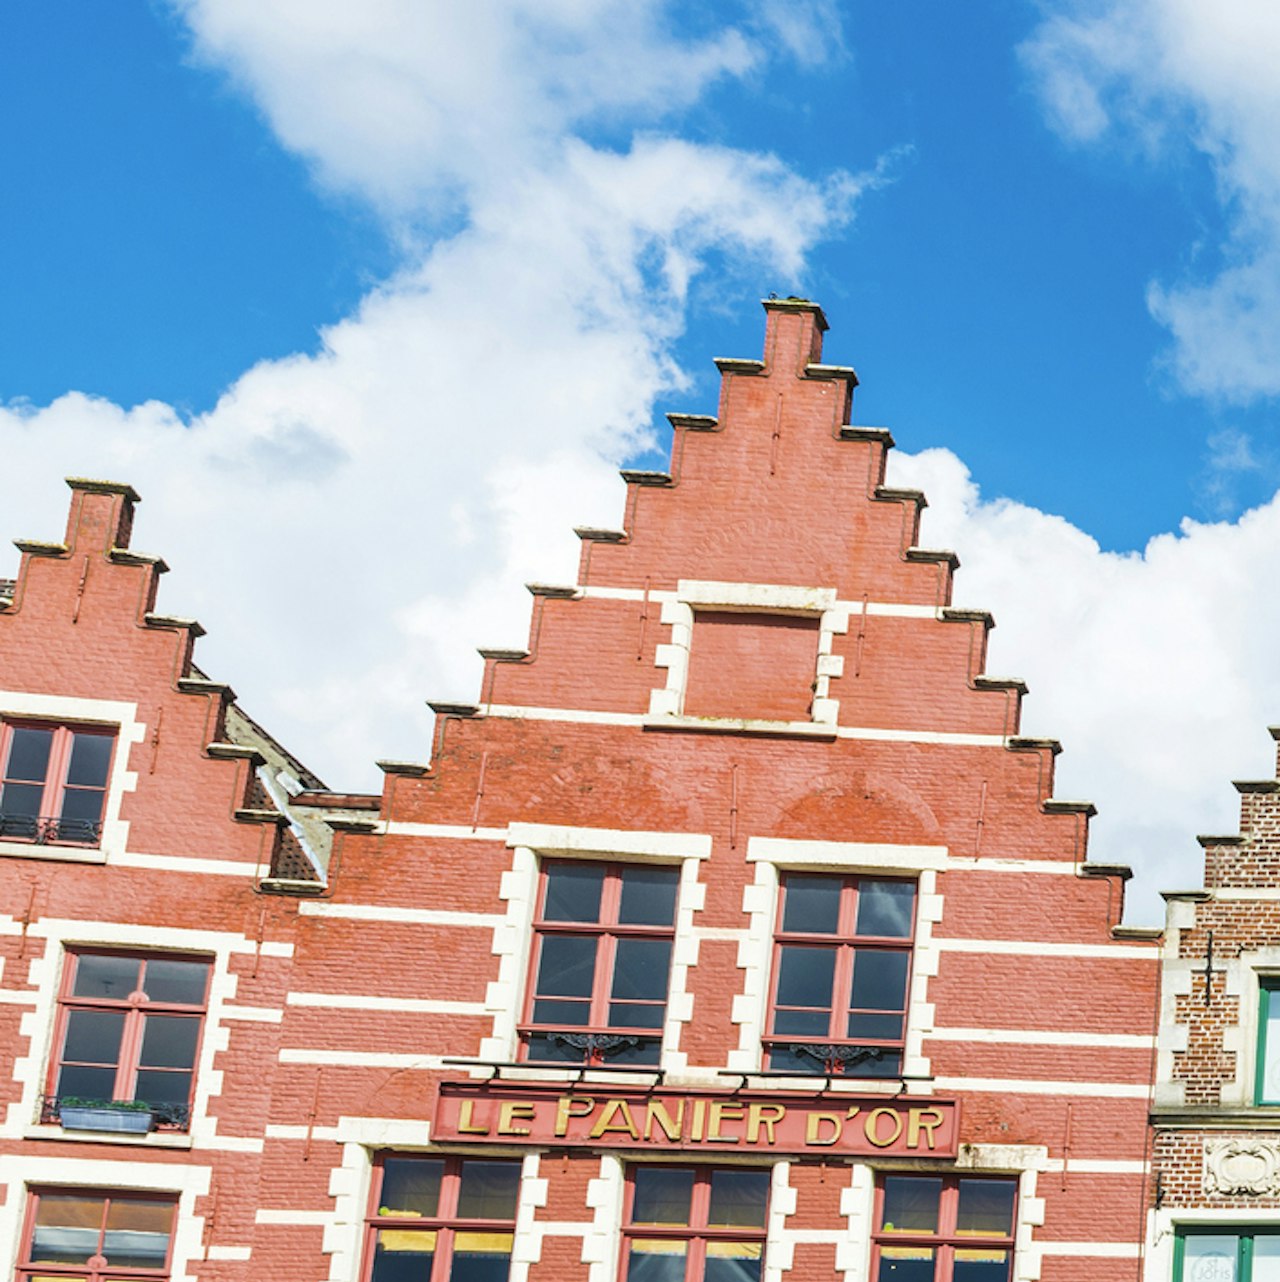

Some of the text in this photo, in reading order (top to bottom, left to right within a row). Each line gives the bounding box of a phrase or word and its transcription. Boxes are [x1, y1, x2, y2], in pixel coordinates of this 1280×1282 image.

[458, 1096, 945, 1150] LE PANIER D'OR
